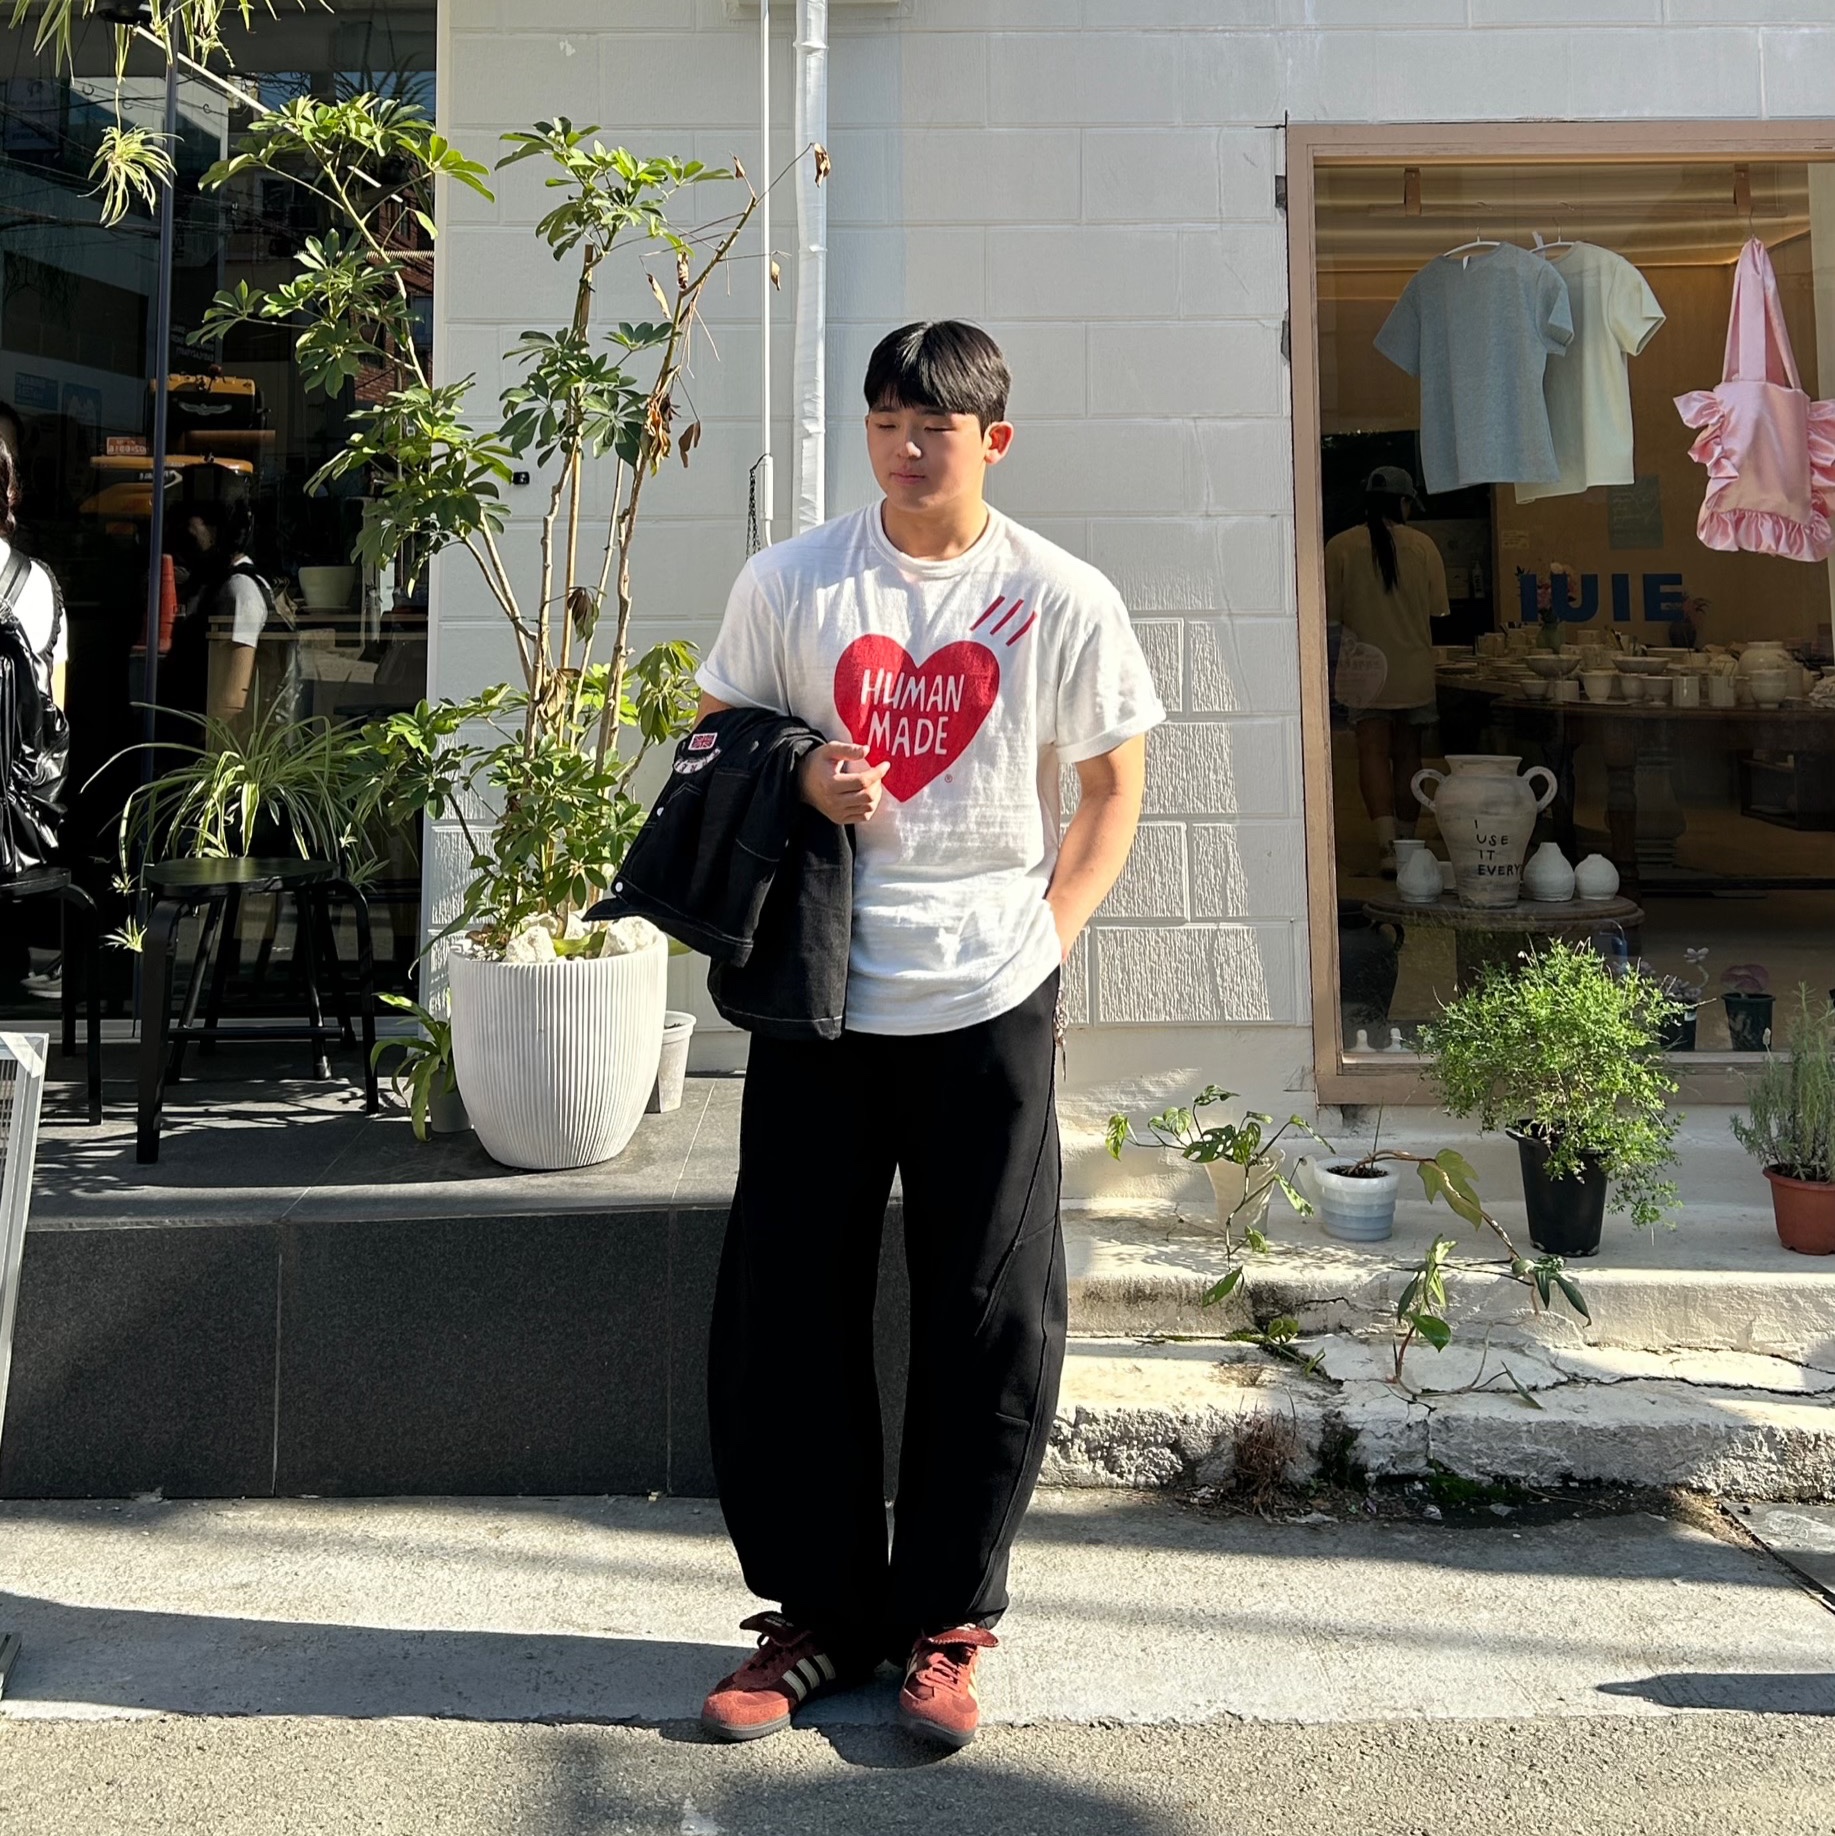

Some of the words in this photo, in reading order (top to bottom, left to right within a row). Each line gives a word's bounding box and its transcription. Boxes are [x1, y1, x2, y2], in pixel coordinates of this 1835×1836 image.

[860, 667, 965, 712] HUMAN
[867, 710, 949, 758] MADE
[1474, 819, 1478, 829] I
[1476, 834, 1508, 846] USE
[1479, 850, 1495, 860] IT
[1478, 864, 1520, 876] EVERY
